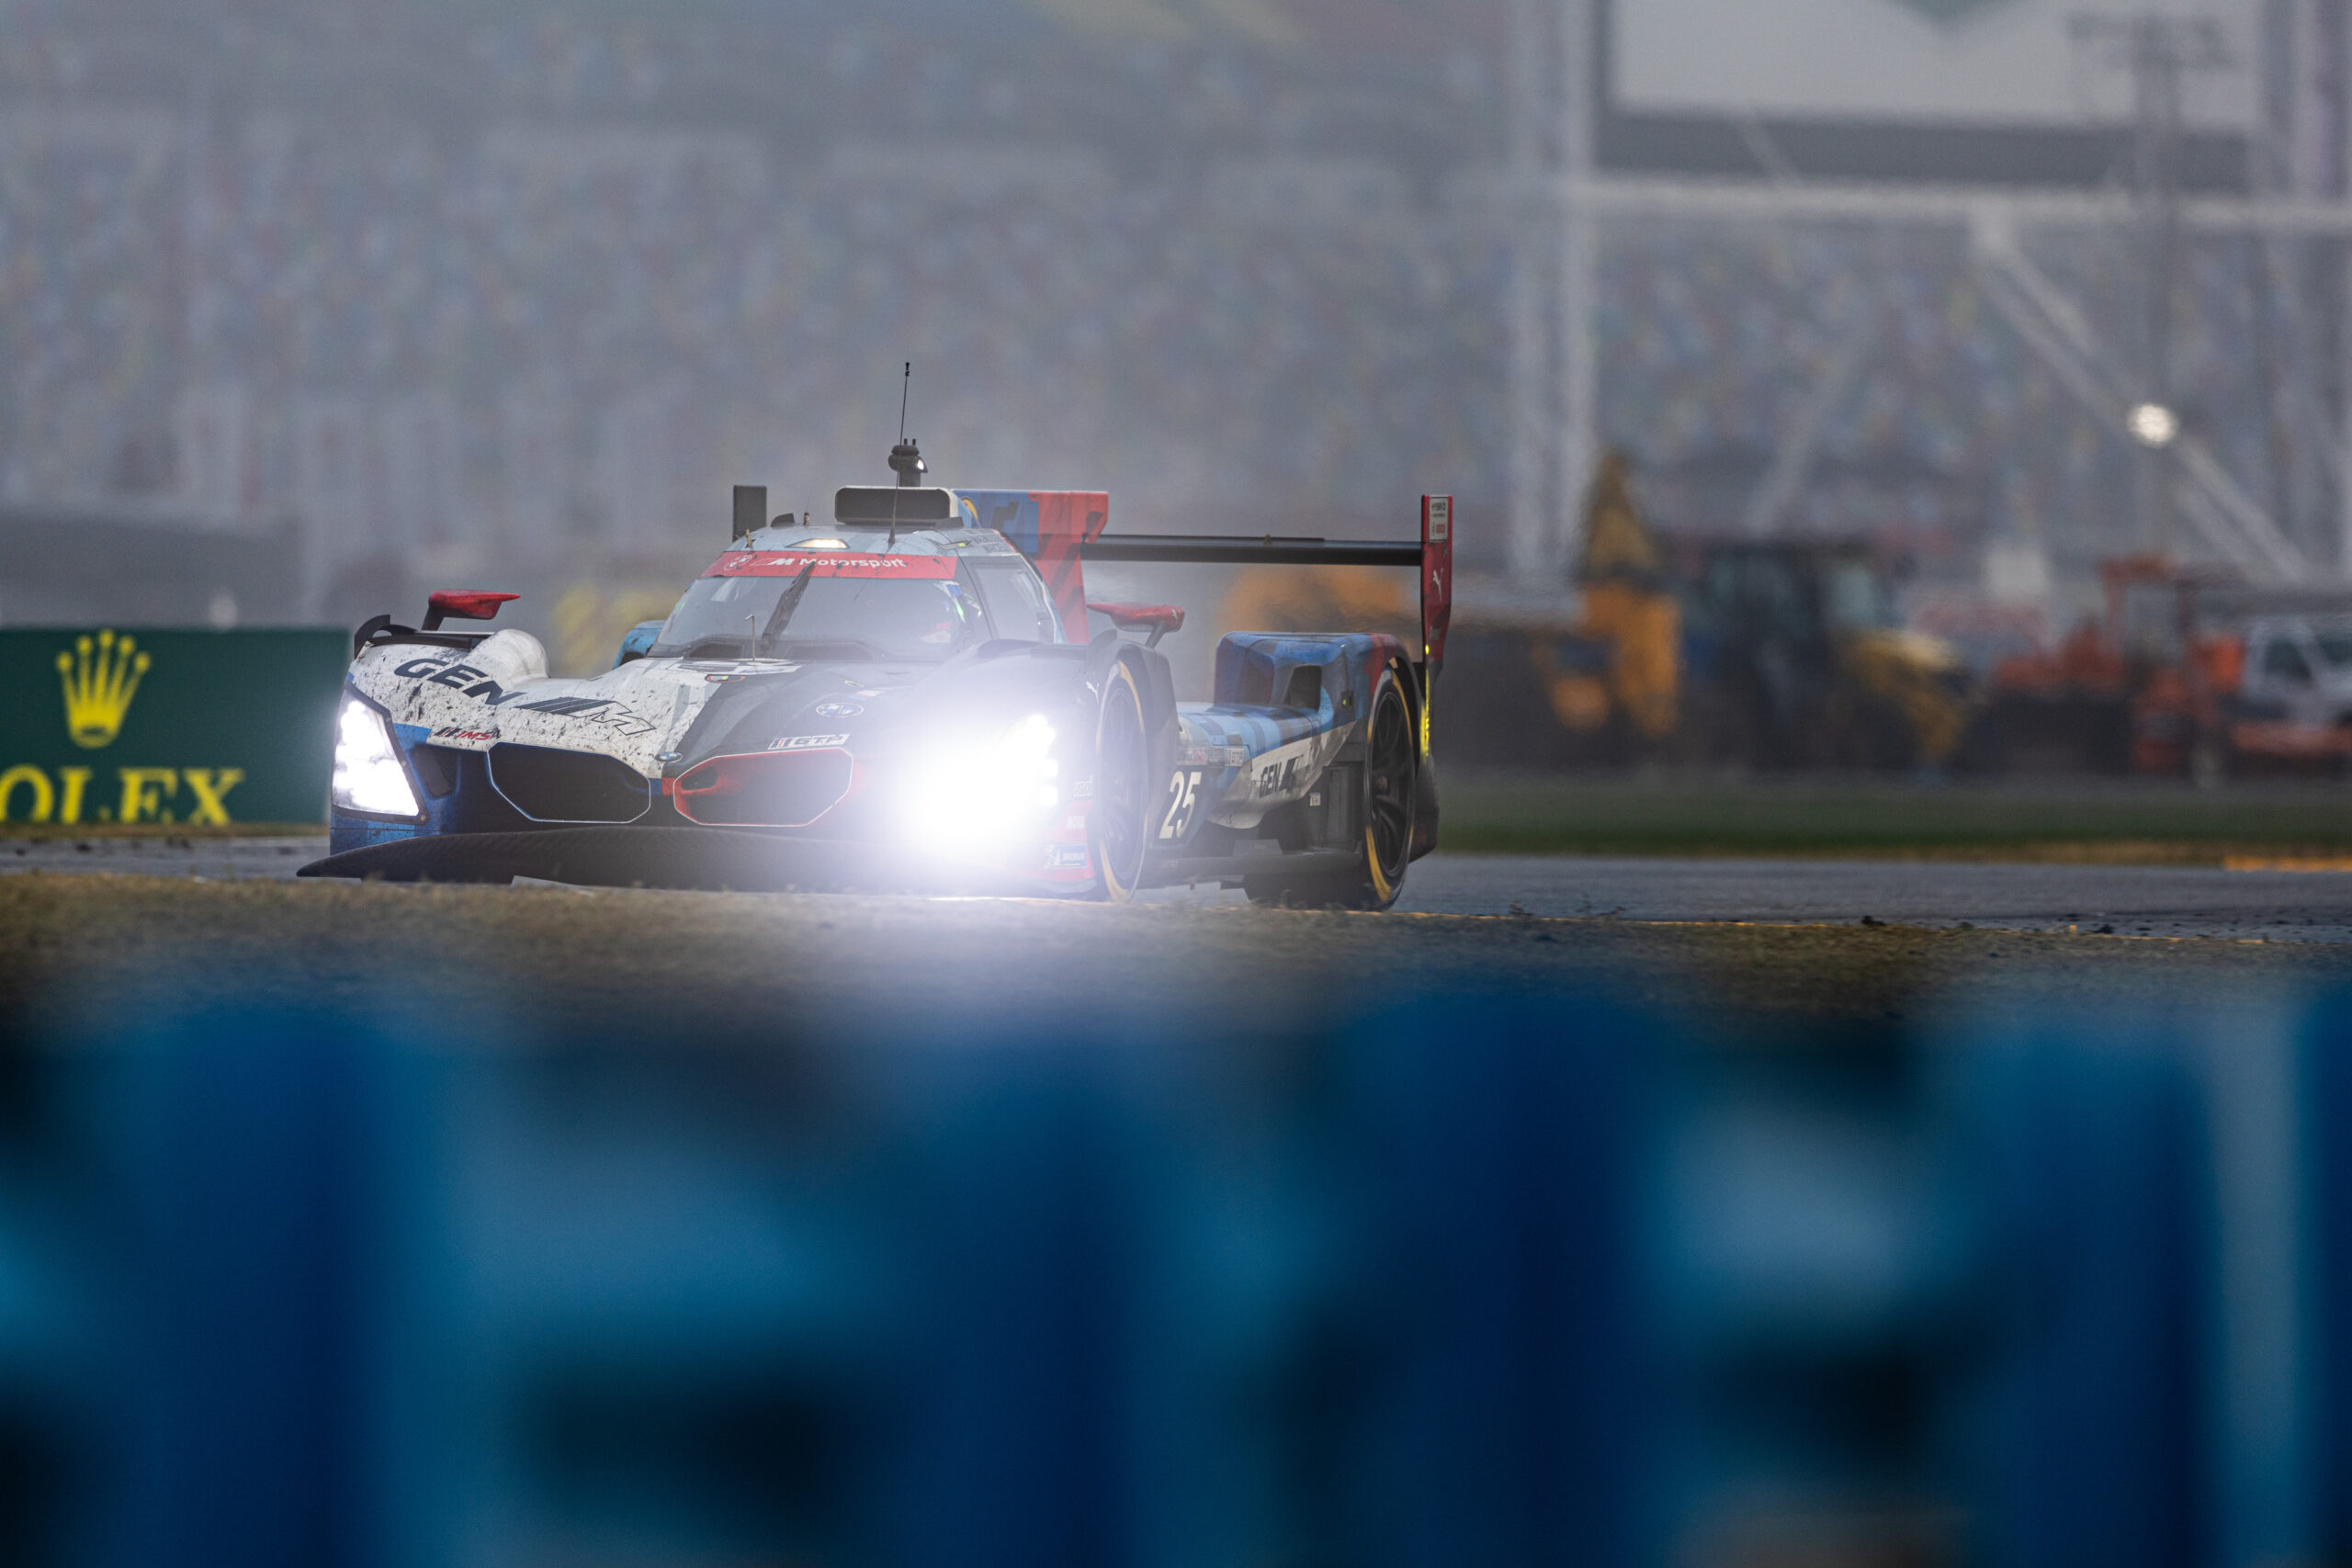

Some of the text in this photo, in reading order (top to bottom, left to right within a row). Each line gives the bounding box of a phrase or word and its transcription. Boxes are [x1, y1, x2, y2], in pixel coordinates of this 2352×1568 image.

[799, 558, 906, 568] Motorsport
[393, 658, 528, 706] GEN
[793, 735, 843, 746] GTP
[1259, 761, 1283, 798] GEN
[1159, 770, 1203, 840] 25
